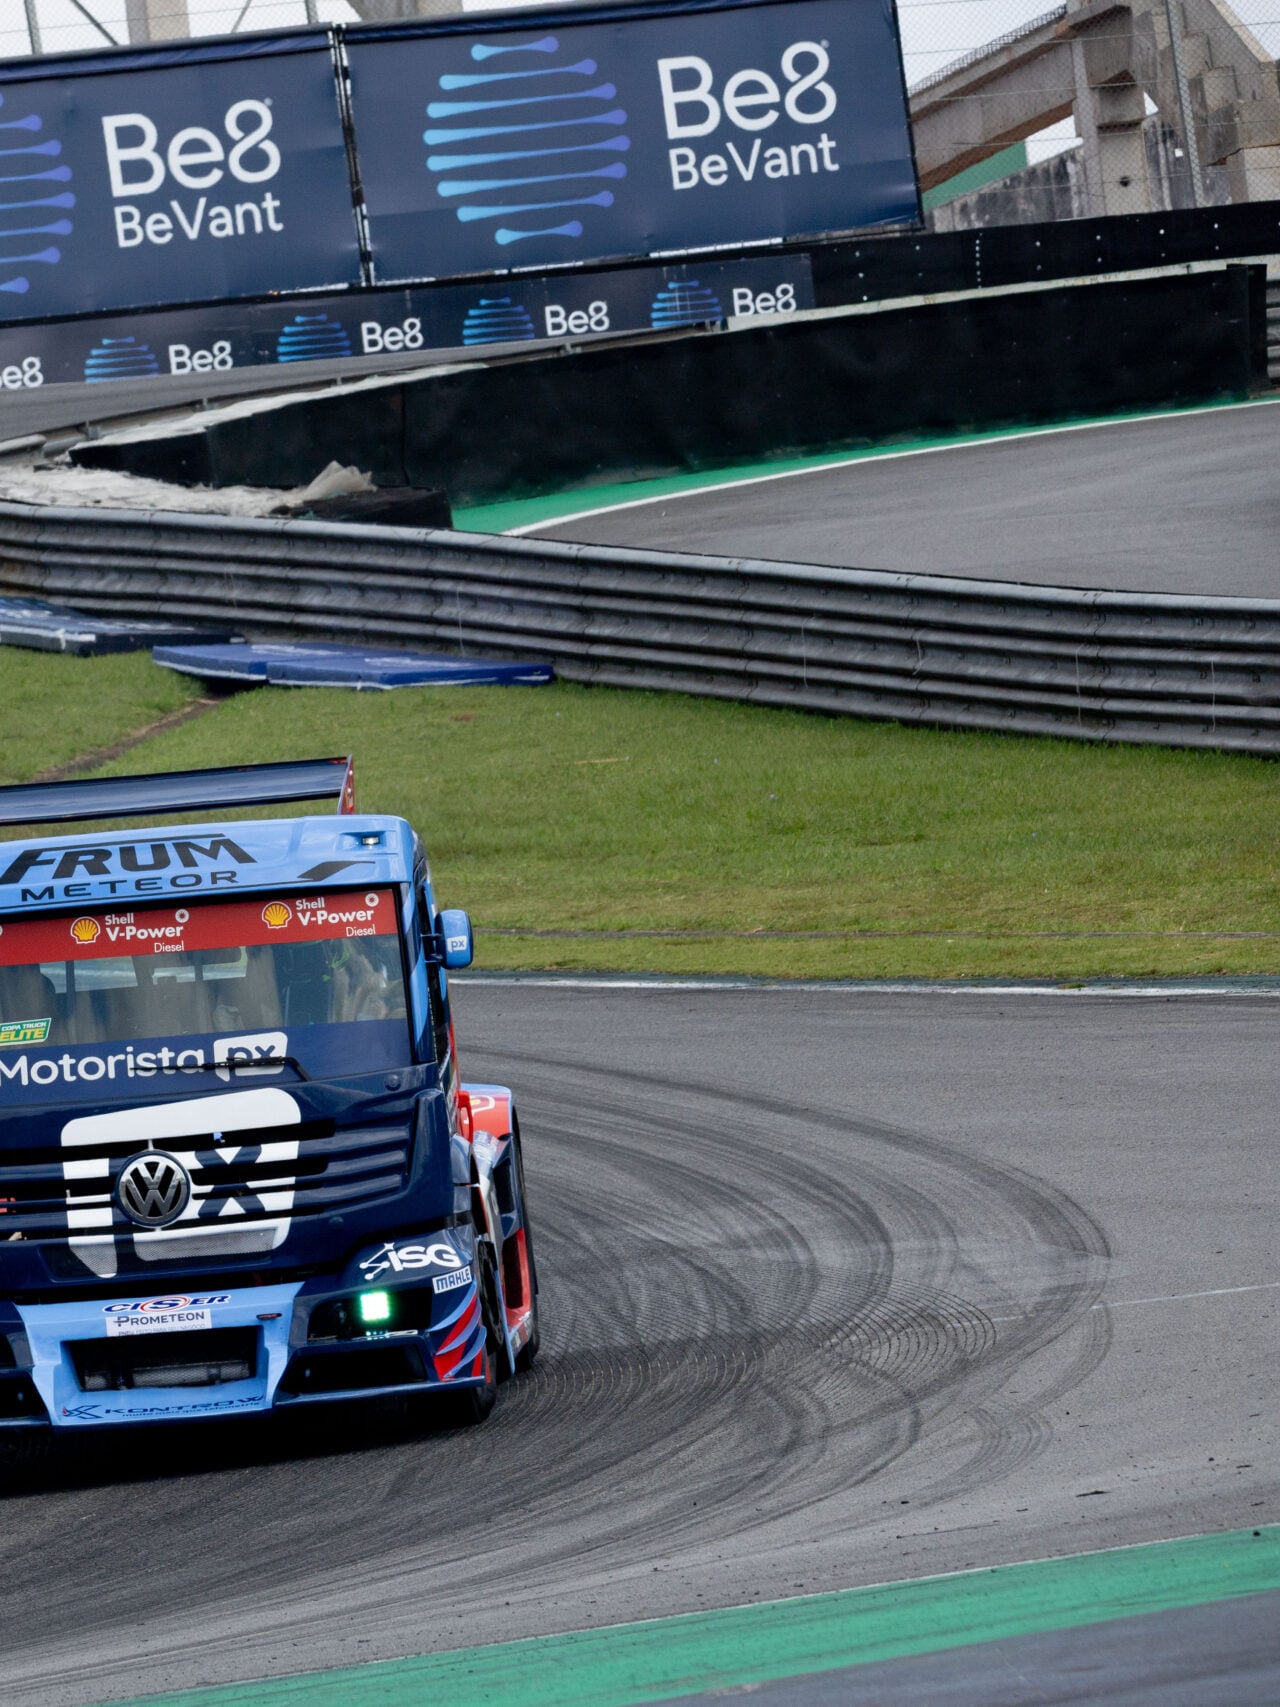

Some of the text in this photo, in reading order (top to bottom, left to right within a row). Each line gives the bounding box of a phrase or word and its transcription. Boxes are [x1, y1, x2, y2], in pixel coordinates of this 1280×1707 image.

[657, 41, 837, 140] Be8
[101, 98, 281, 198] Be8
[669, 133, 840, 190] BeVant
[114, 192, 284, 248] BeVant
[732, 283, 797, 316] Be8
[544, 301, 610, 336] Be8
[361, 318, 424, 353] Be8
[168, 340, 233, 376] Be8
[21, 870, 239, 902] METEOR
[296, 897, 325, 910] Shell
[104, 912, 134, 925] Shell
[297, 909, 374, 926] V-Power
[106, 926, 184, 942] V-Power
[345, 923, 376, 937] Diesel
[154, 940, 185, 953] Diesel
[23, 1021, 47, 1029] TRUCK
[436, 1269, 471, 1291] MAHLE
[103, 1295, 230, 1312] CISER
[114, 1311, 205, 1327] PROMETEON
